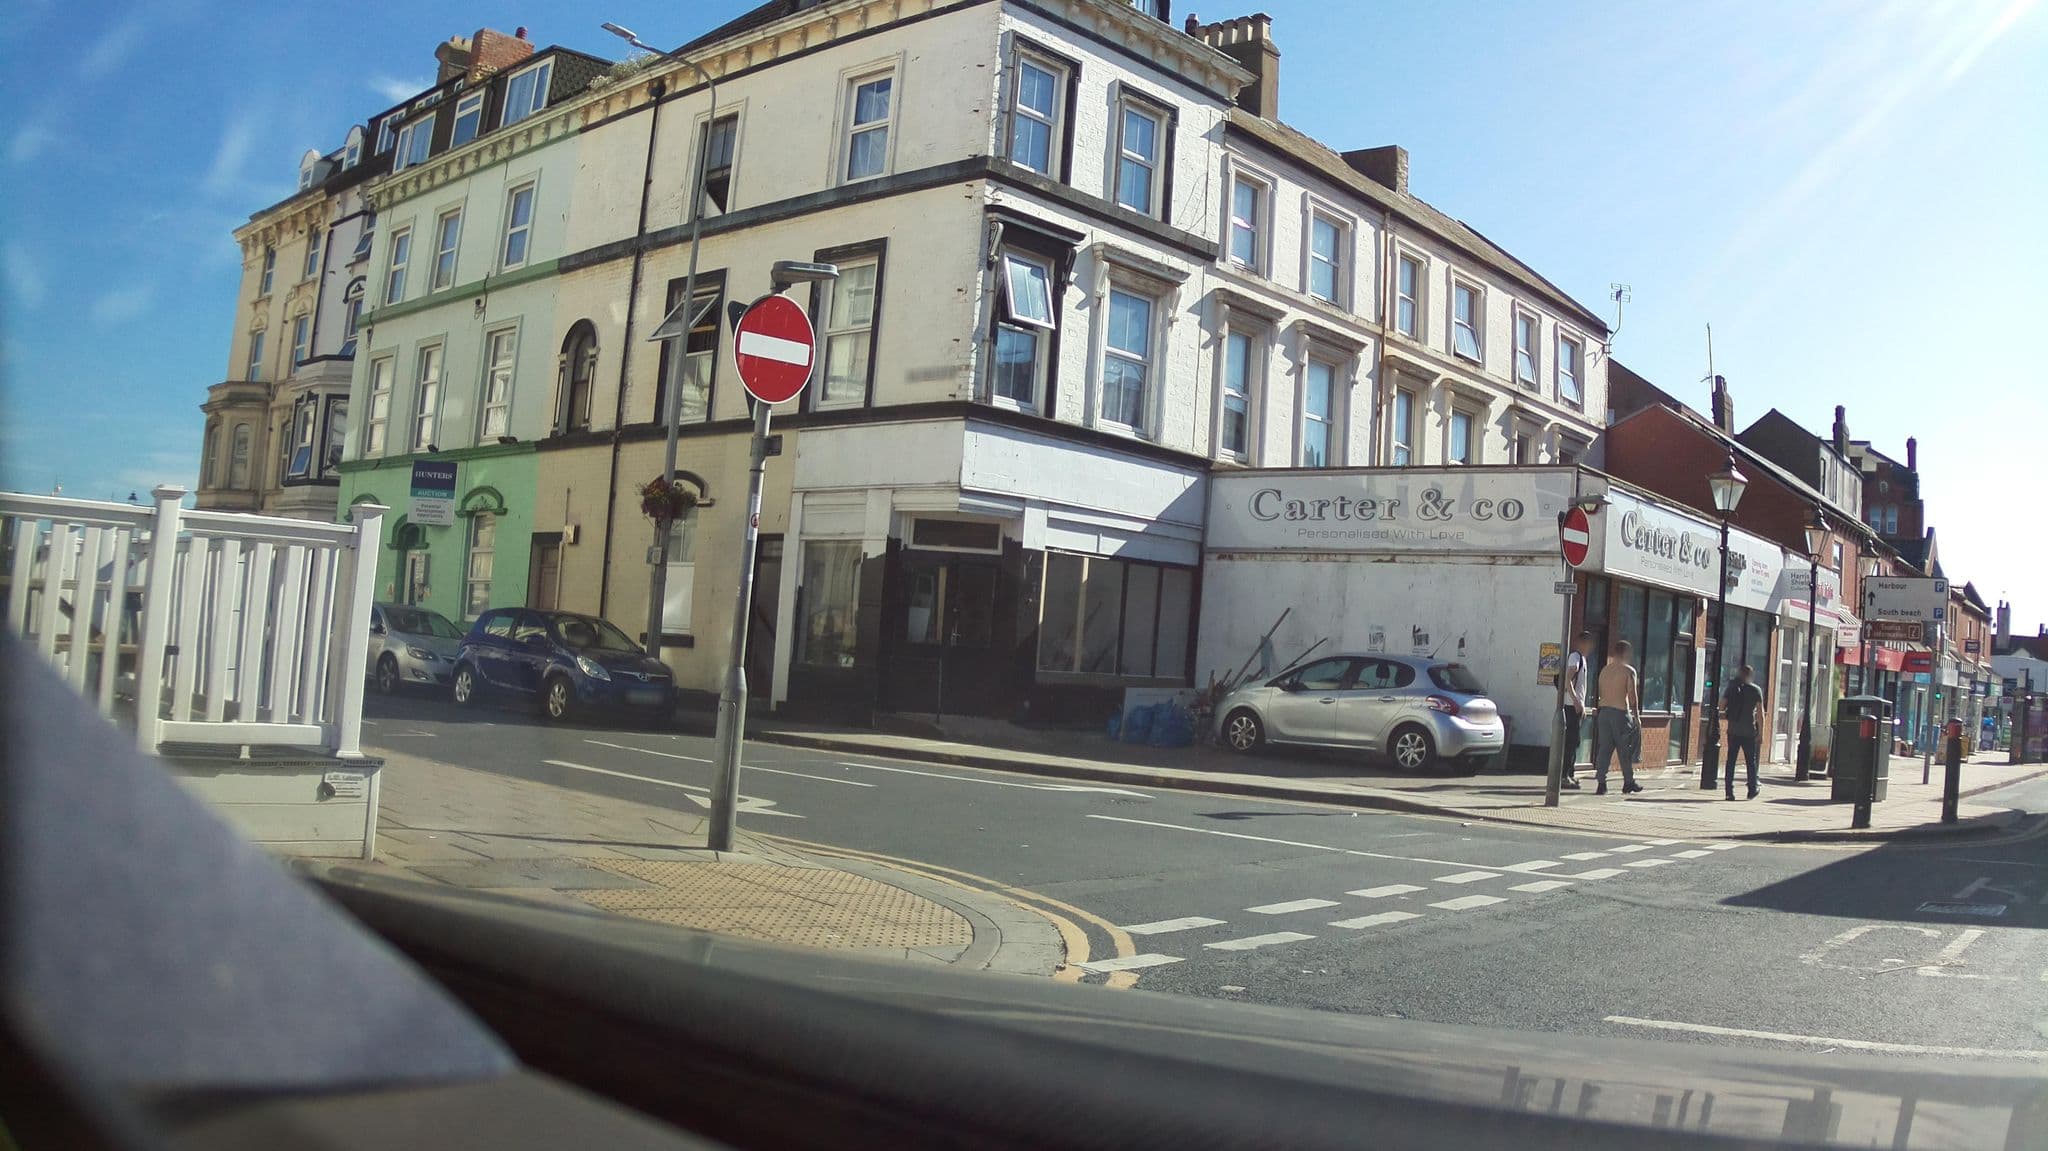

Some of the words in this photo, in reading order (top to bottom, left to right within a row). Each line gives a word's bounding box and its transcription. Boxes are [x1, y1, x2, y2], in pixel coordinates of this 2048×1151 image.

[415, 471, 453, 479] HUNTERS
[1248, 487, 1401, 521] Carter
[1416, 488, 1455, 521] &
[1469, 498, 1524, 521] co
[1297, 528, 1389, 540] Personalised
[1393, 529, 1425, 540] With
[1430, 529, 1465, 541] Love
[1621, 510, 1677, 560] Carter
[1679, 530, 1693, 565] &
[1694, 544, 1711, 570] co
[1878, 582, 1907, 590] Harbour
[1877, 608, 1899, 616] South
[1901, 608, 1922, 617] beach
